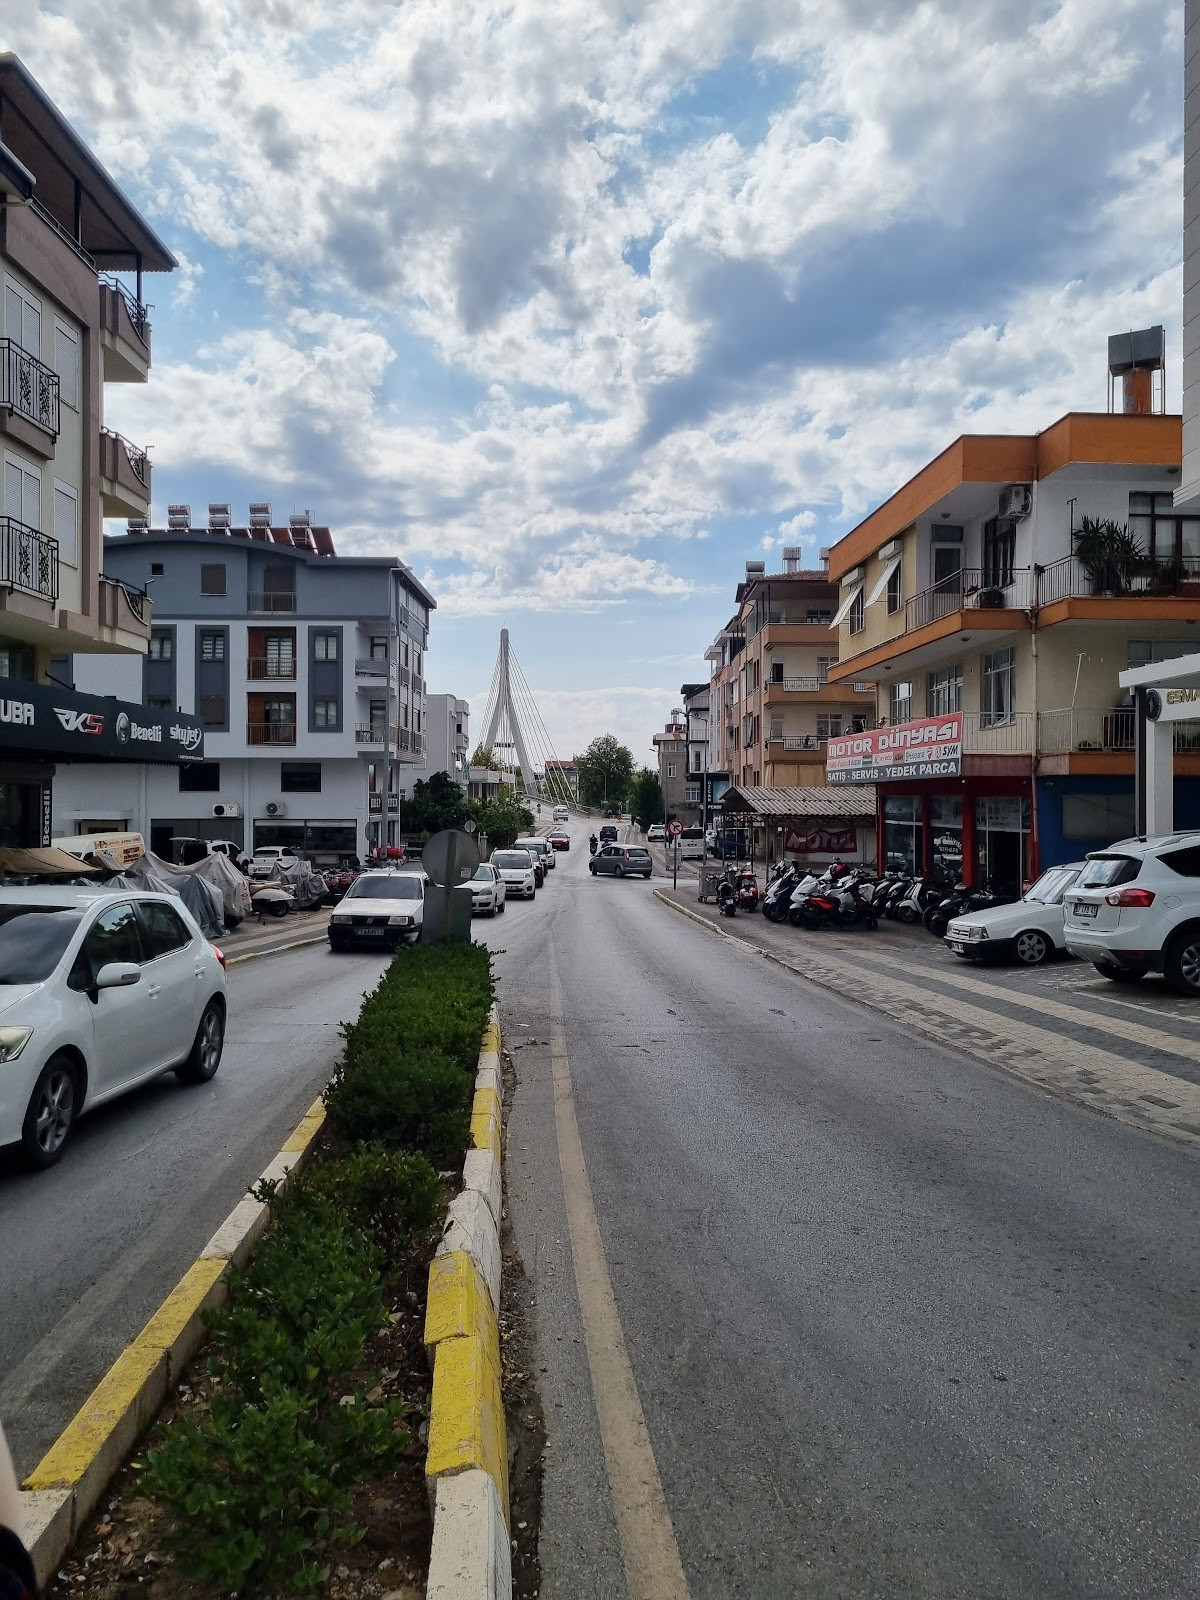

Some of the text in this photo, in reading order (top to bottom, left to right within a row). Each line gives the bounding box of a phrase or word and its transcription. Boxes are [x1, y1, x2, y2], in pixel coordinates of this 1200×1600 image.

[52, 707, 104, 735] RKS
[131, 722, 162, 743] Benelli
[169, 724, 200, 747] skyjet
[829, 721, 958, 758] MOTOR DÜNYASI
[942, 744, 959, 757] SYM
[827, 771, 846, 783] SATIŞ
[851, 768, 879, 780] SERVİS
[885, 764, 917, 777] YEDEK
[43, 790, 51, 845] Benelli
[787, 831, 855, 850] MOTUL
